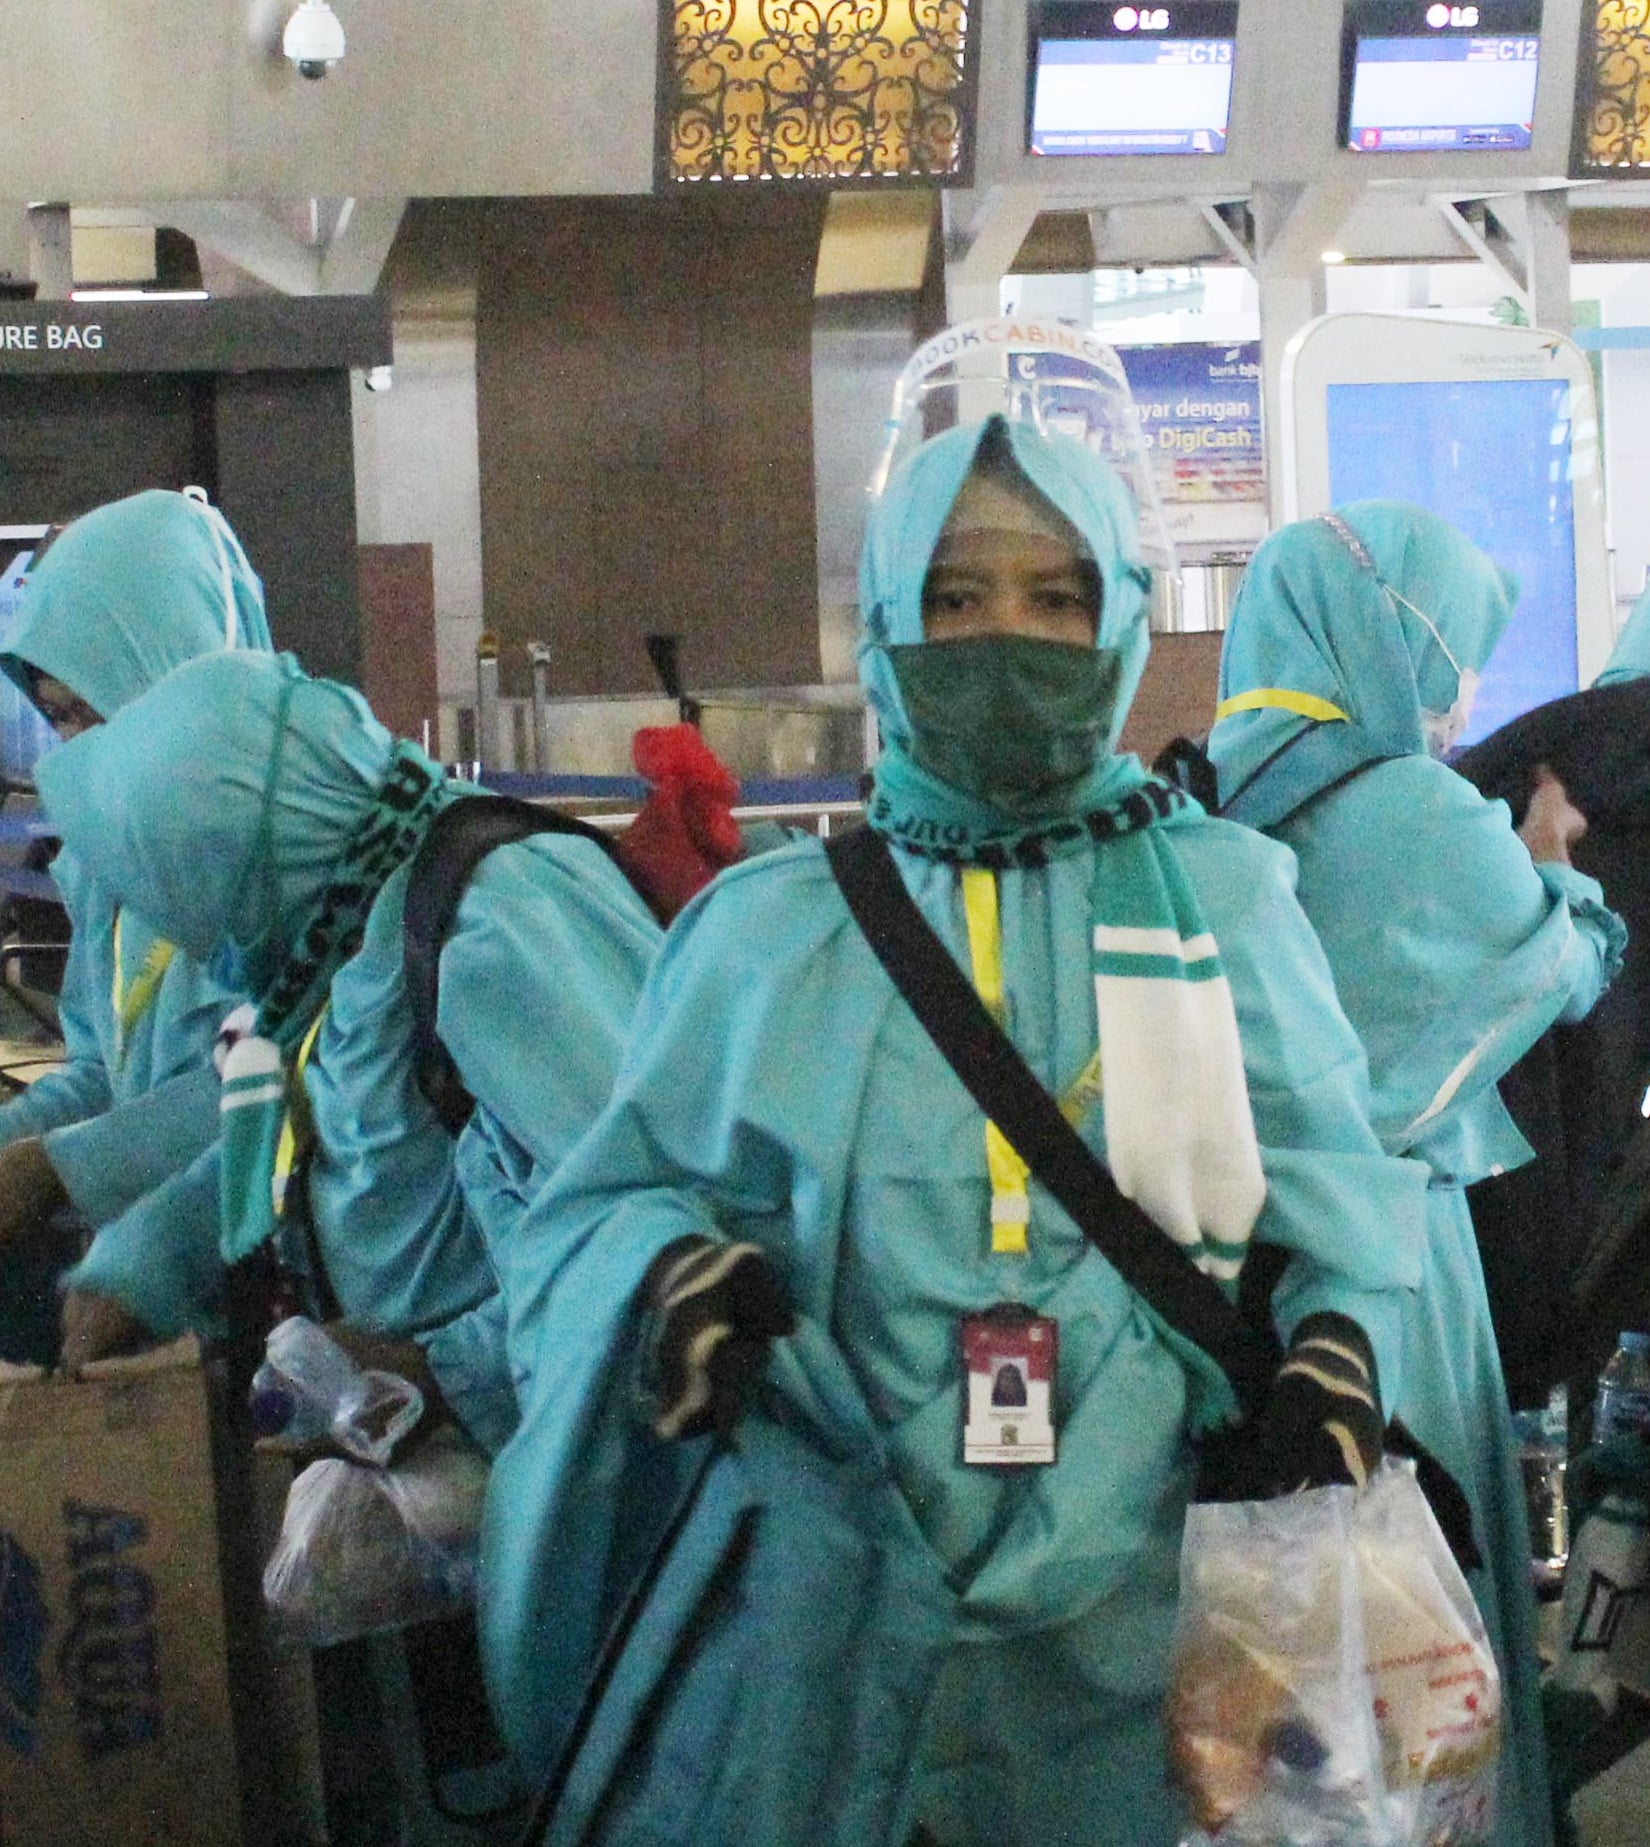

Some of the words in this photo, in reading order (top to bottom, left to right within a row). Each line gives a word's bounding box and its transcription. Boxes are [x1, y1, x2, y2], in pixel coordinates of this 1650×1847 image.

[1139, 8, 1171, 30] LG
[1449, 6, 1480, 27] LG
[1190, 43, 1232, 63] C13
[1499, 40, 1538, 60] C12
[47, 324, 103, 350] BAG
[1176, 397, 1250, 420] dengan
[1159, 426, 1252, 453] DigiCash
[58, 1497, 162, 1758] AQUA
